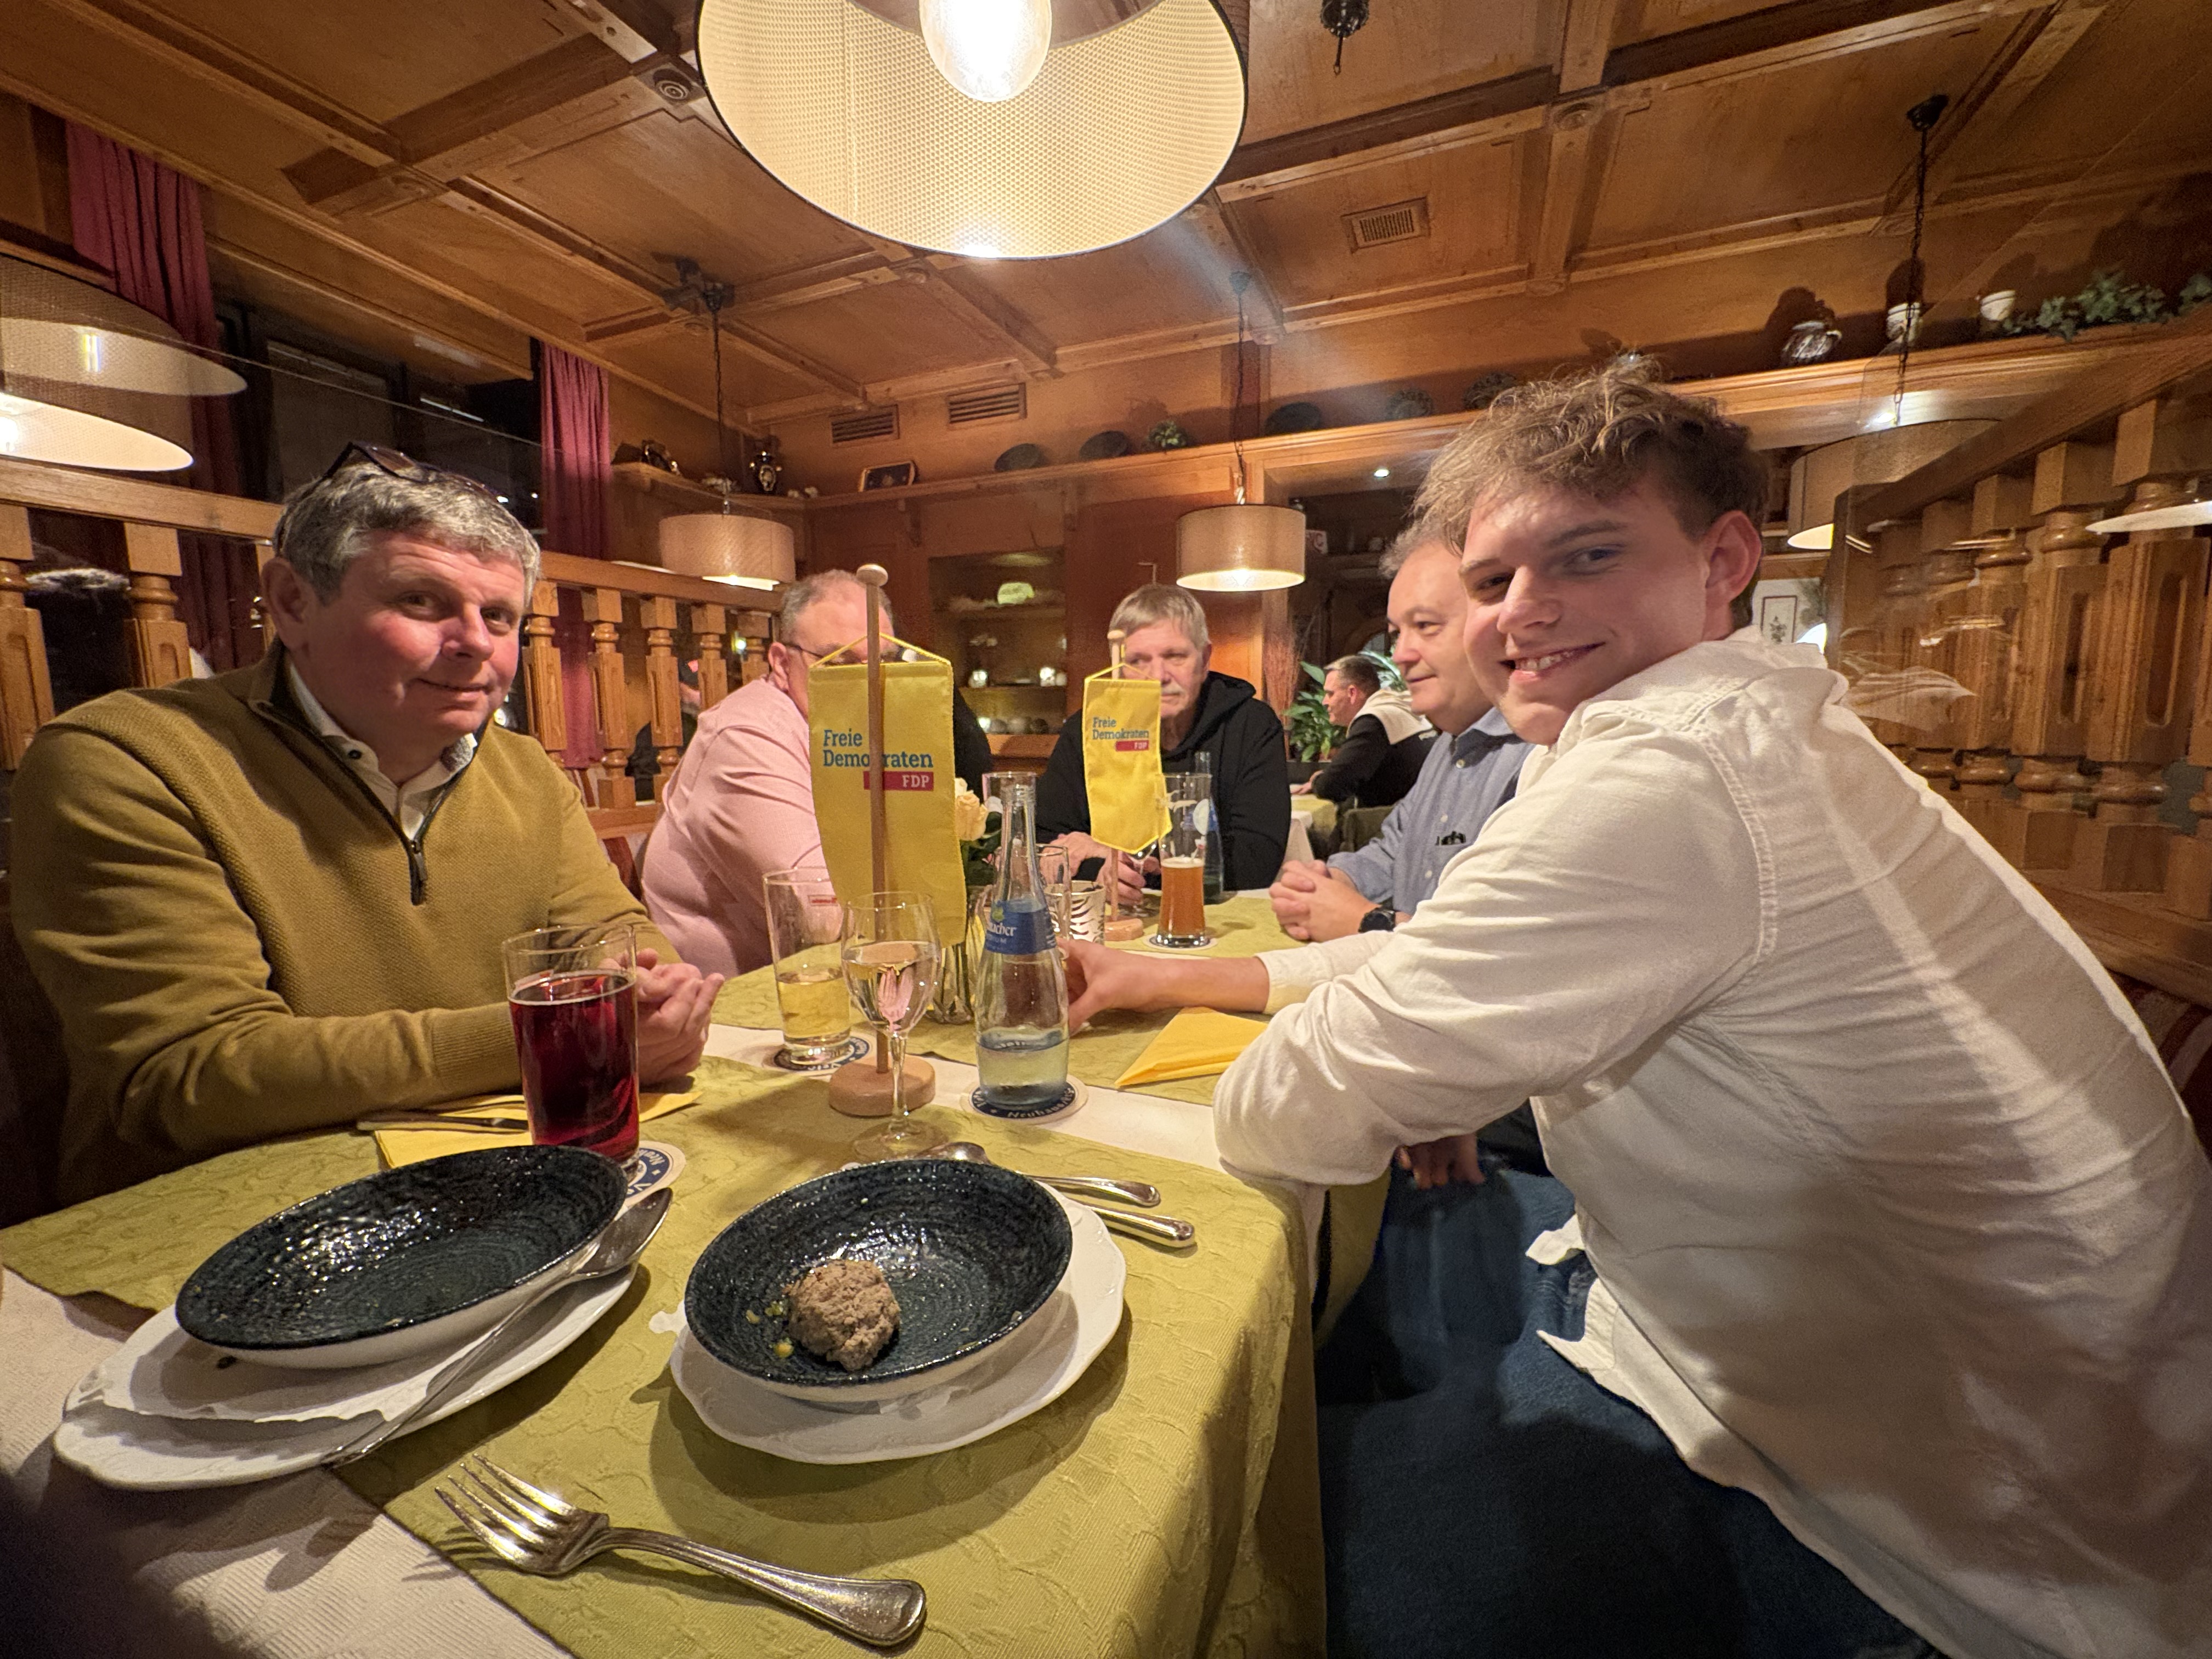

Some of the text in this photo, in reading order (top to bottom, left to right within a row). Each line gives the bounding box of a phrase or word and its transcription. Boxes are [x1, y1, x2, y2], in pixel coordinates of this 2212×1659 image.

[1093, 717, 1116, 727] Freie
[823, 728, 862, 747] Freie
[1093, 729, 1149, 740] Demokraten
[823, 749, 933, 768] Demoraten
[902, 775, 929, 788] FDP
